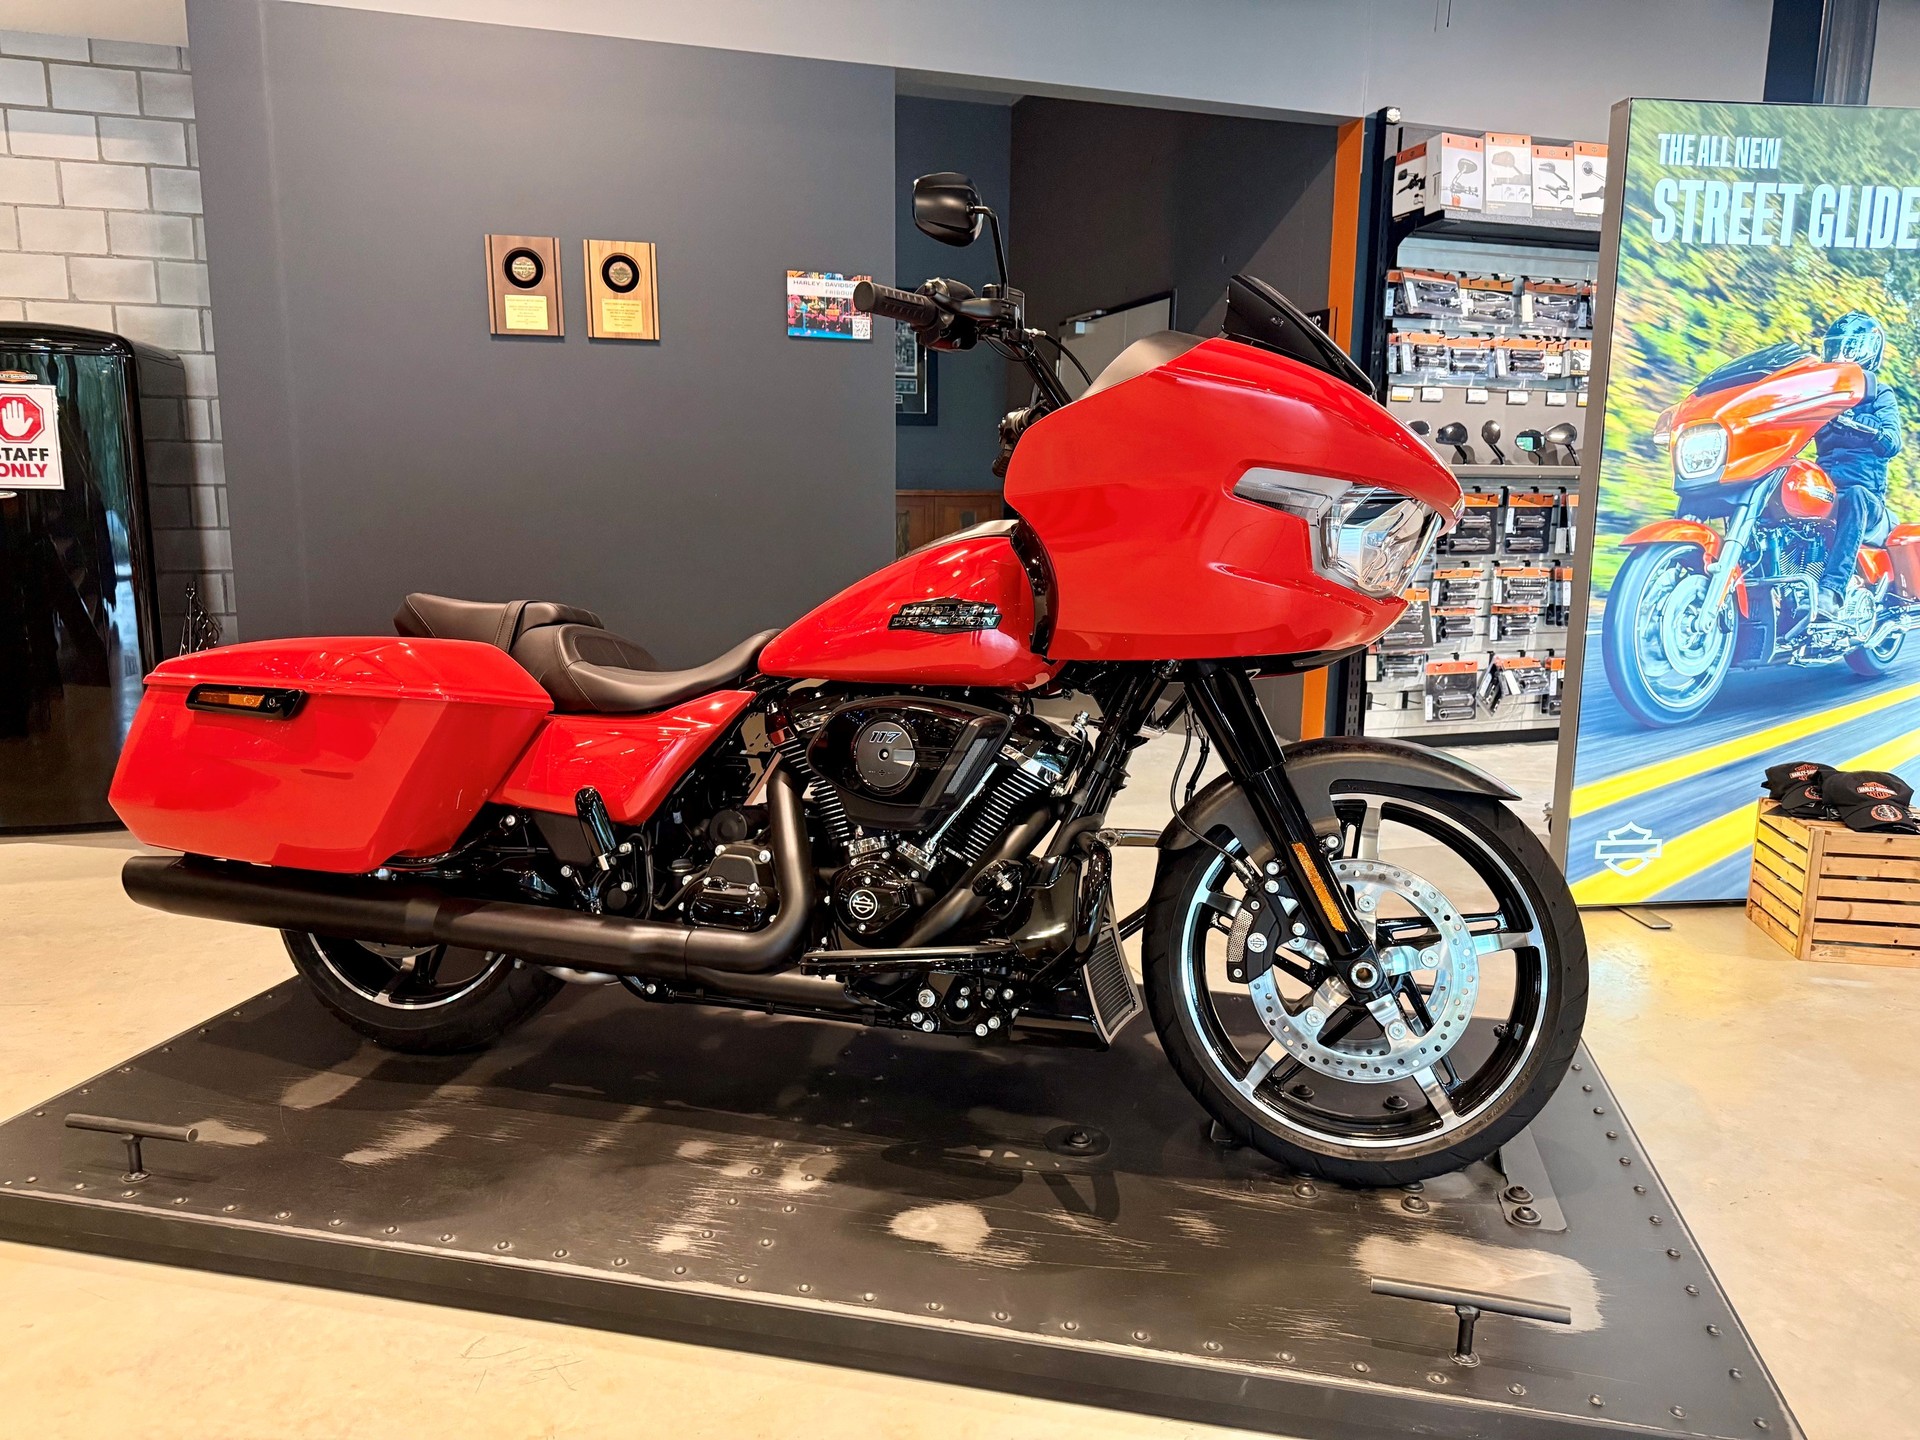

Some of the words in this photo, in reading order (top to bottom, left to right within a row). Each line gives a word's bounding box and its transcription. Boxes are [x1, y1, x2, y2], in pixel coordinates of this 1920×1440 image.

[1658, 133, 1696, 166] THE
[1697, 135, 1731, 168] ALL
[1734, 136, 1782, 169] NEW
[1651, 178, 1804, 247] STREET
[1807, 183, 1920, 249] GLIDE
[0, 447, 49, 461] TAFF
[0, 463, 48, 478] ONLY
[891, 615, 997, 627] DAVIDSON
[869, 731, 902, 743] 117
